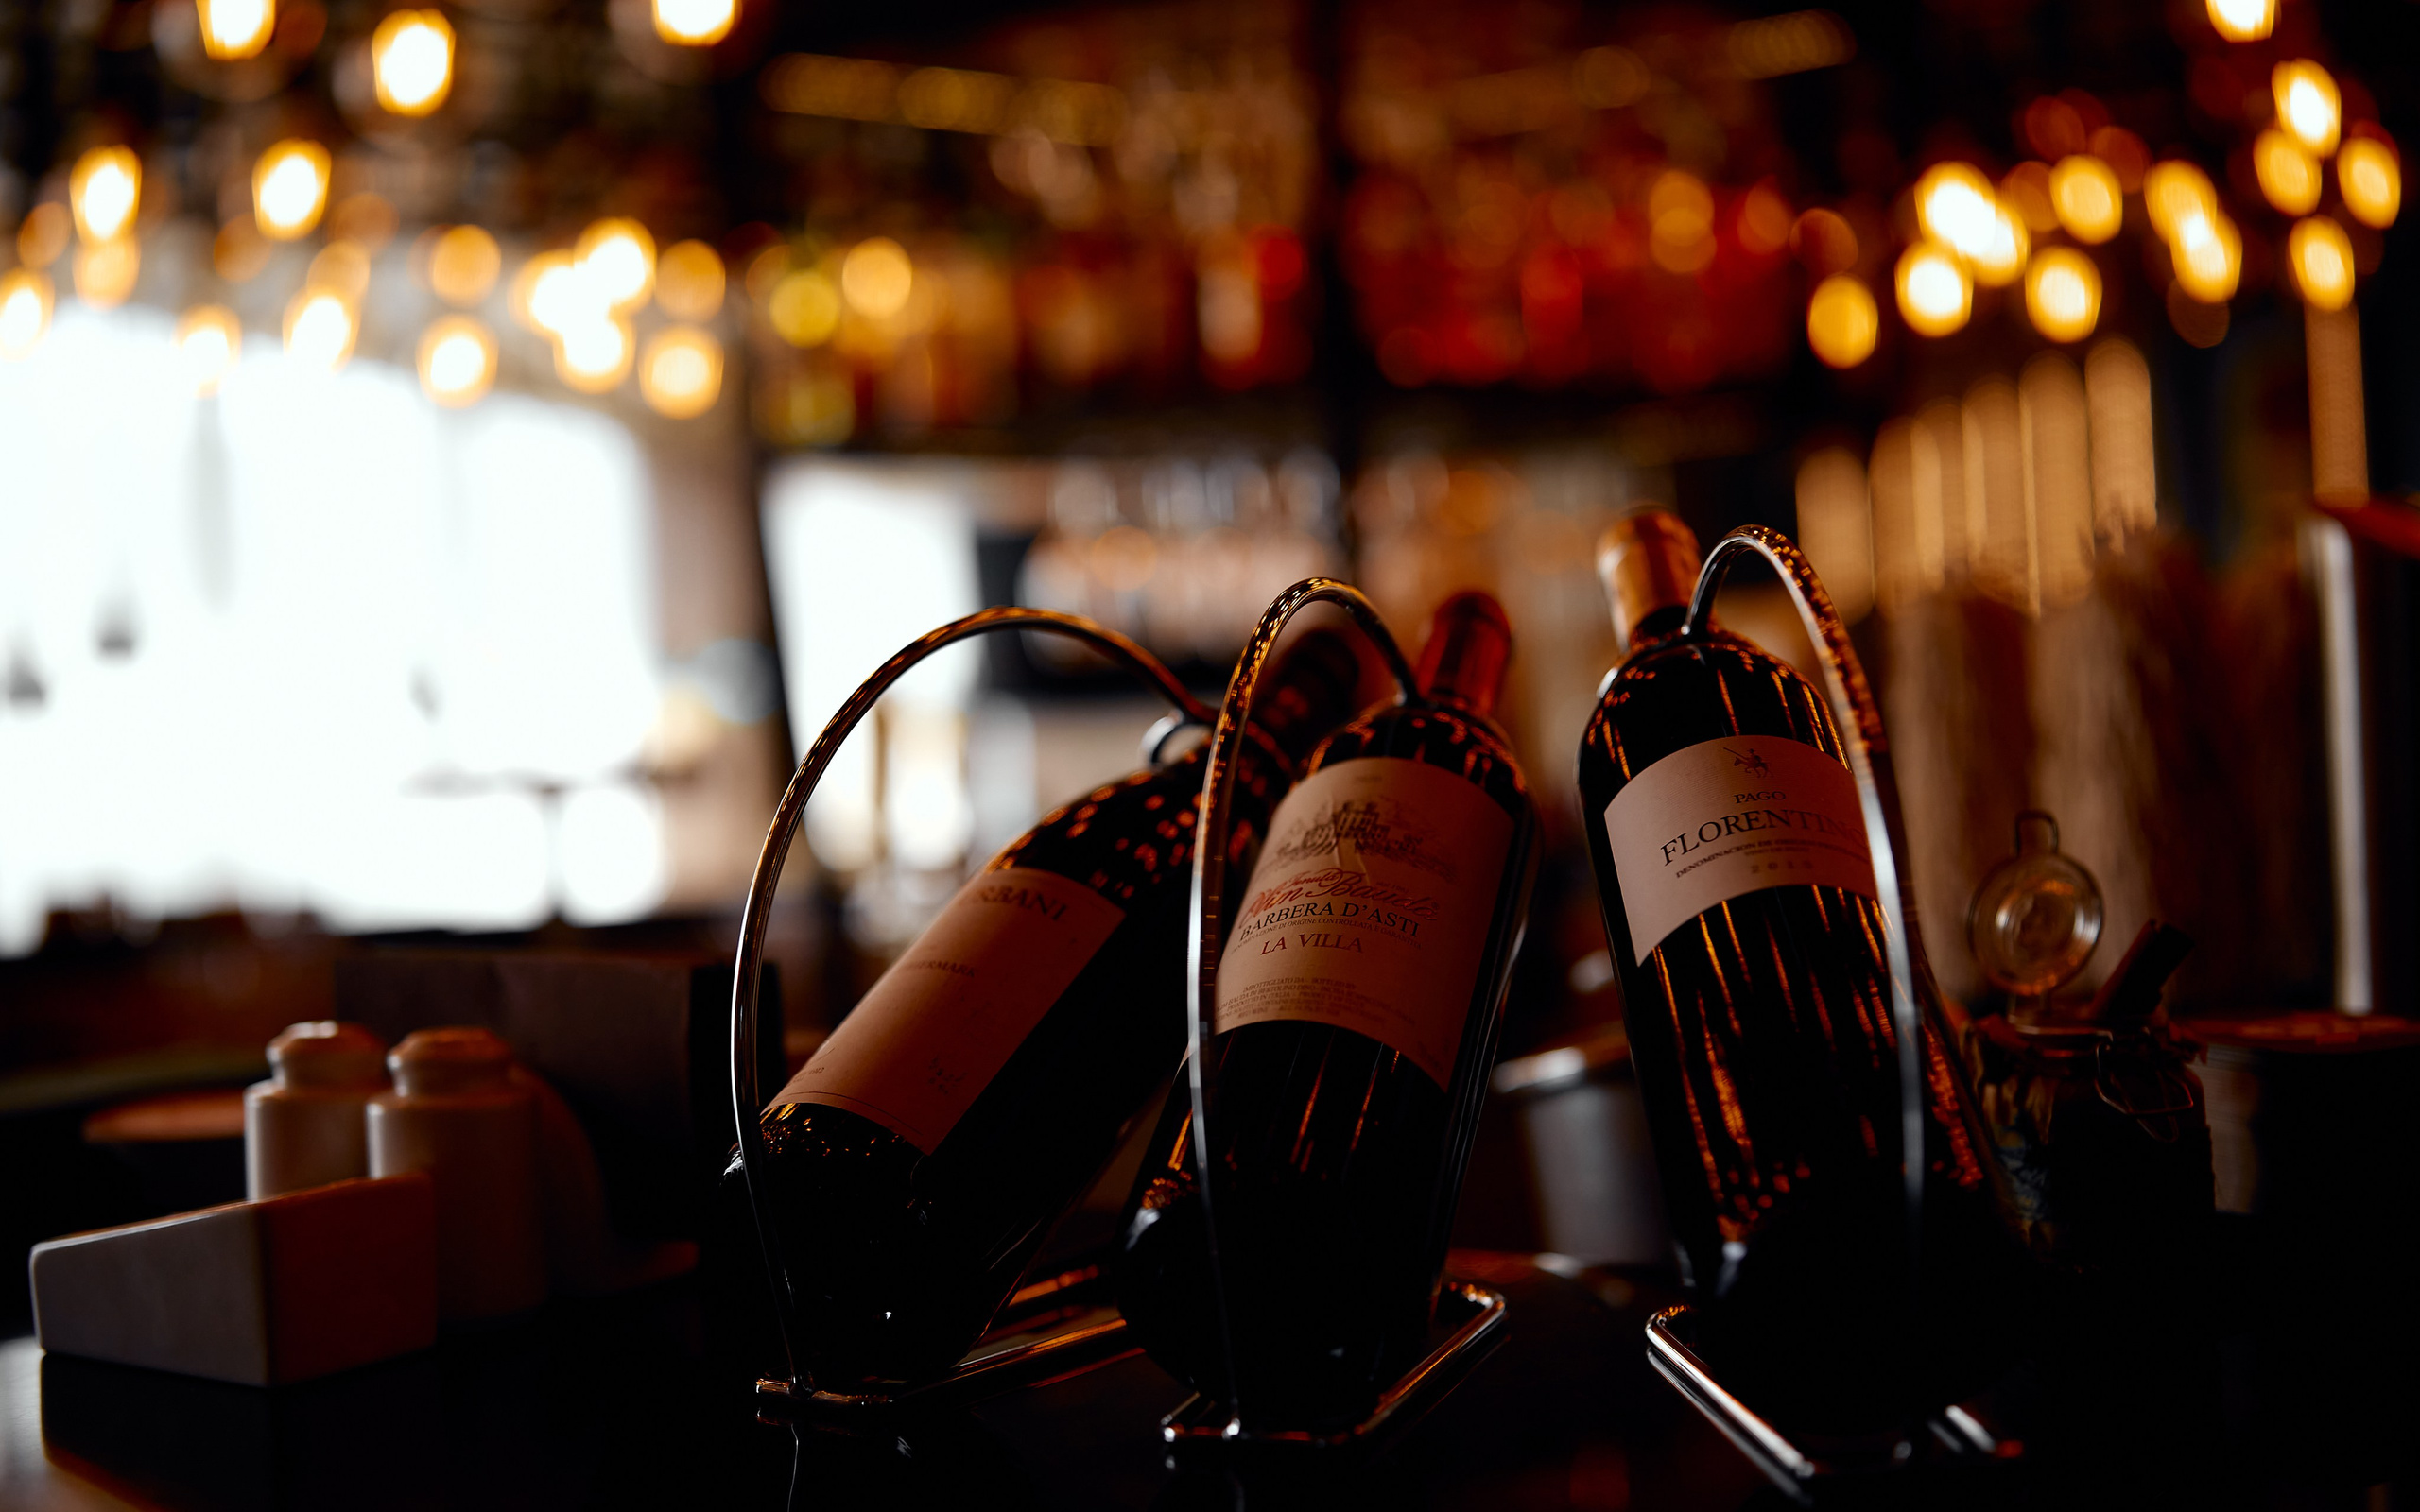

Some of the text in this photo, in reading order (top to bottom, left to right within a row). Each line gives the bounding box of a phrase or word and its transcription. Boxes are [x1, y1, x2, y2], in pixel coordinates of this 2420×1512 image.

[1734, 791, 1788, 804] PAGO
[1660, 809, 1869, 867] FLORENTINO
[1239, 902, 1334, 941] BARBERA
[1287, 918, 1317, 928] ORIGINE
[1318, 917, 1373, 932] CONTROLLATA
[1260, 933, 1364, 956] LA VILLA
